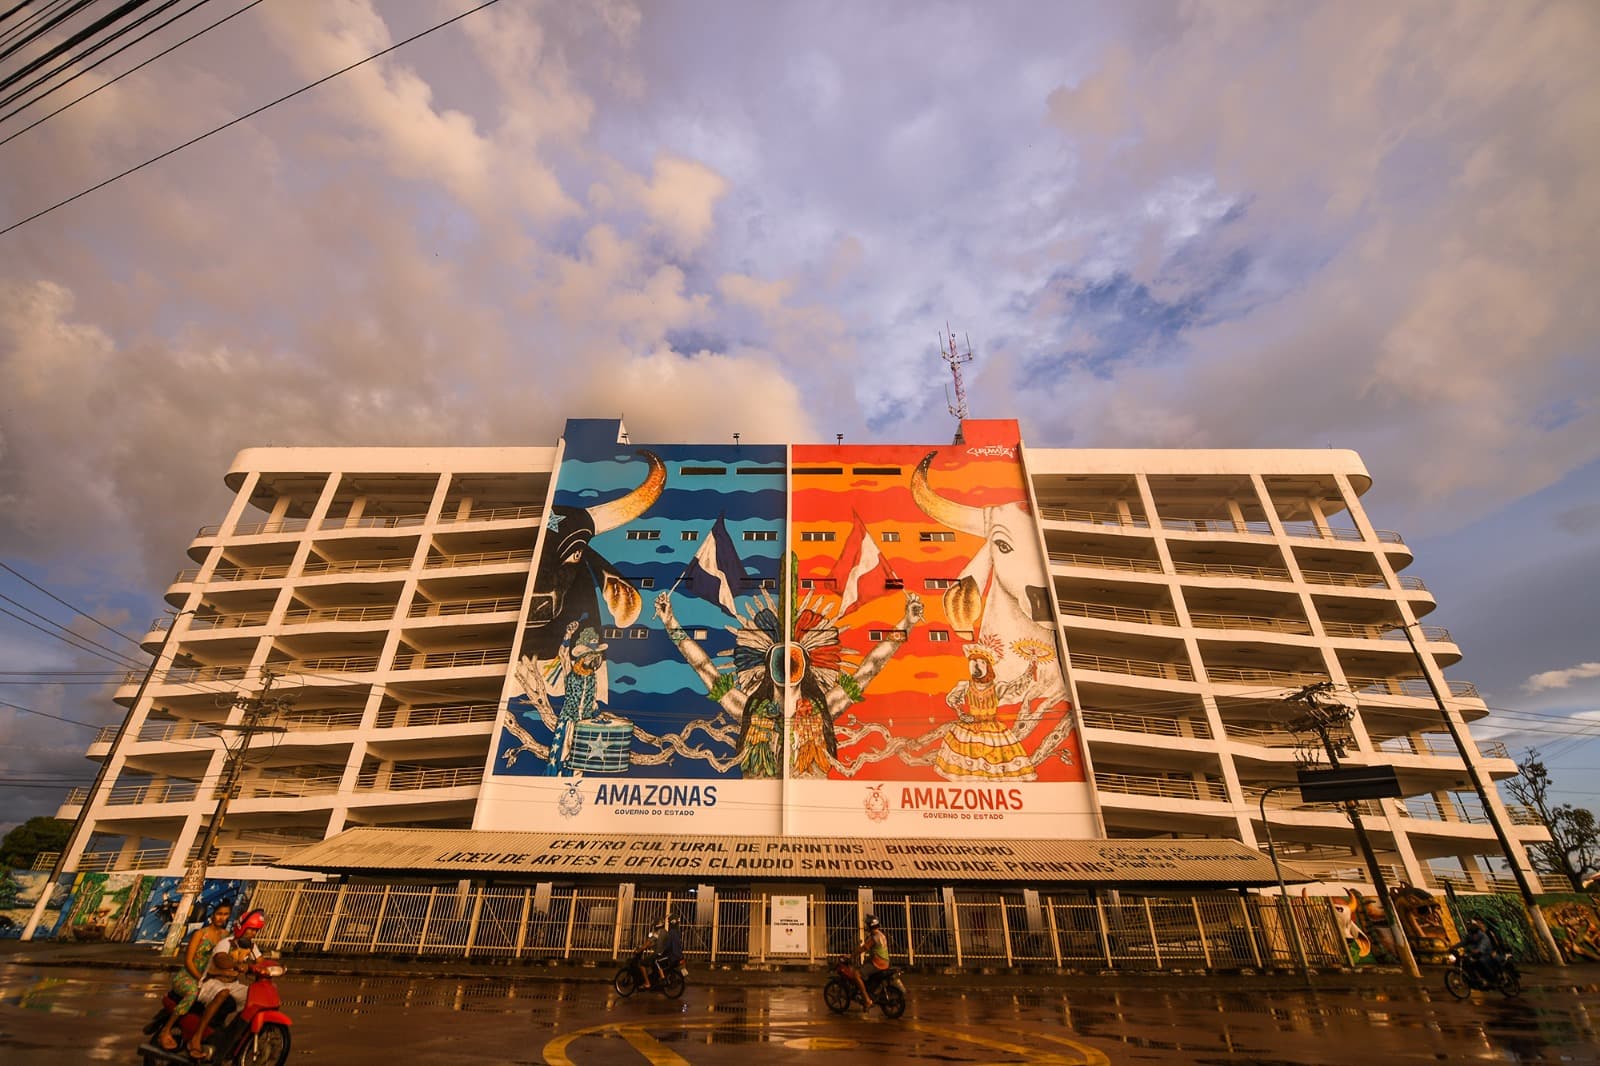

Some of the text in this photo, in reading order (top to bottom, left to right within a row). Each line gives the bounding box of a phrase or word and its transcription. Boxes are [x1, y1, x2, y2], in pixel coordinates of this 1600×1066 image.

[594, 783, 717, 807] AMAZONAS
[901, 787, 1023, 811] AMAZONAS
[923, 812, 959, 820] GOVERNO
[549, 840, 626, 850] CENTRO
[629, 841, 729, 852] CULTURAL
[735, 842, 761, 853] DE
[766, 843, 865, 854] PARINTINS
[434, 852, 501, 863] LICEU
[498, 853, 531, 864] DE
[530, 854, 602, 866] ARTES
[603, 855, 622, 866] E
[708, 857, 794, 869] CLAUDIO
[801, 858, 894, 871] SANTORO
[913, 860, 1004, 872] UNIDADE
[1003, 861, 1115, 873] PARINTINS
